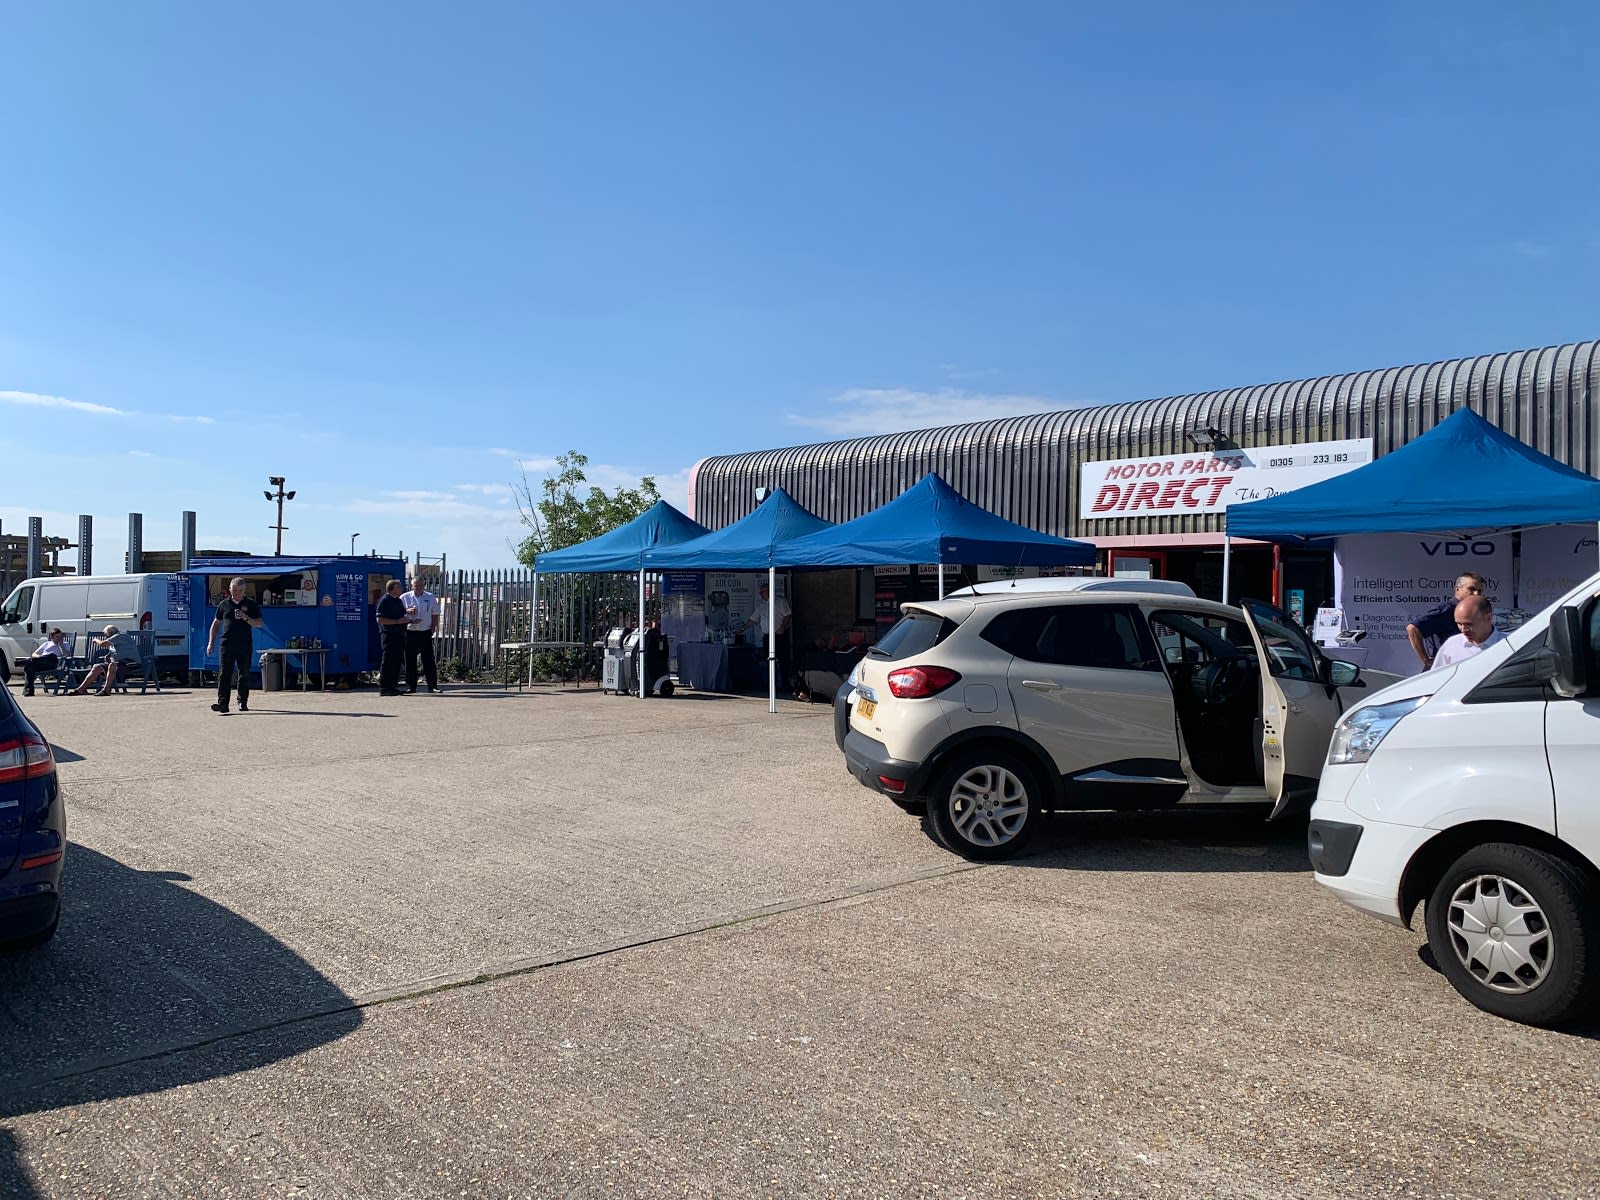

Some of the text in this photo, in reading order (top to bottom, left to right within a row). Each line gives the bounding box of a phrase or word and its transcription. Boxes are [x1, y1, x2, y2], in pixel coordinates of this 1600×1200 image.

[1270, 453, 1348, 467] 01305 233 183
[1104, 455, 1244, 481] MOTOR PARTS
[1091, 475, 1234, 513] DIRECT
[1235, 488, 1260, 500] The
[1420, 541, 1496, 556] VDO
[1353, 577, 1413, 591] Intelligent
[1353, 595, 1392, 603] Efficient
[1394, 595, 1440, 603] Solutions
[1362, 614, 1405, 623] Diagnostic
[1363, 623, 1379, 632] Tyre
